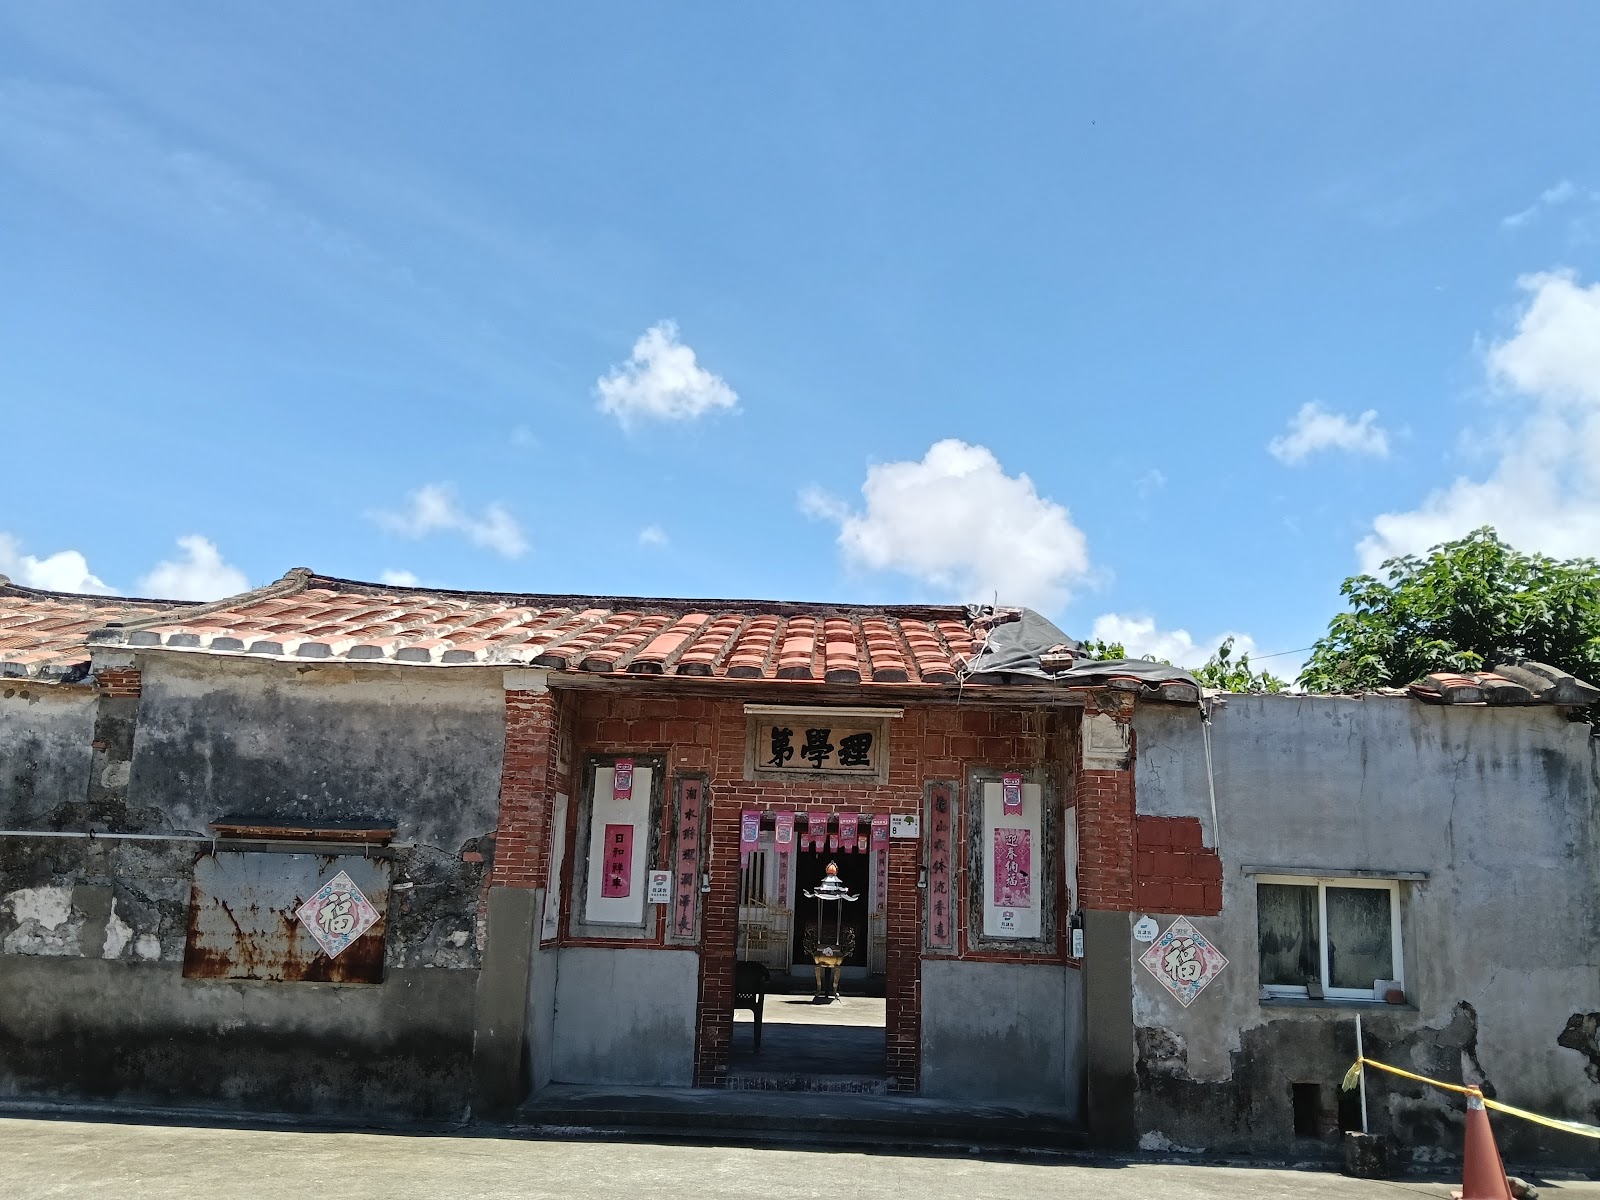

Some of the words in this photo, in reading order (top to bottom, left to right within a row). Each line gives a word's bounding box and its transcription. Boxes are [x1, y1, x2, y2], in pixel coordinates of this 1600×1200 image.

[892, 826, 897, 835] 8
[1004, 833, 1019, 888] 迎春納福
[318, 892, 355, 935] 福
[1164, 937, 1203, 982] 福
